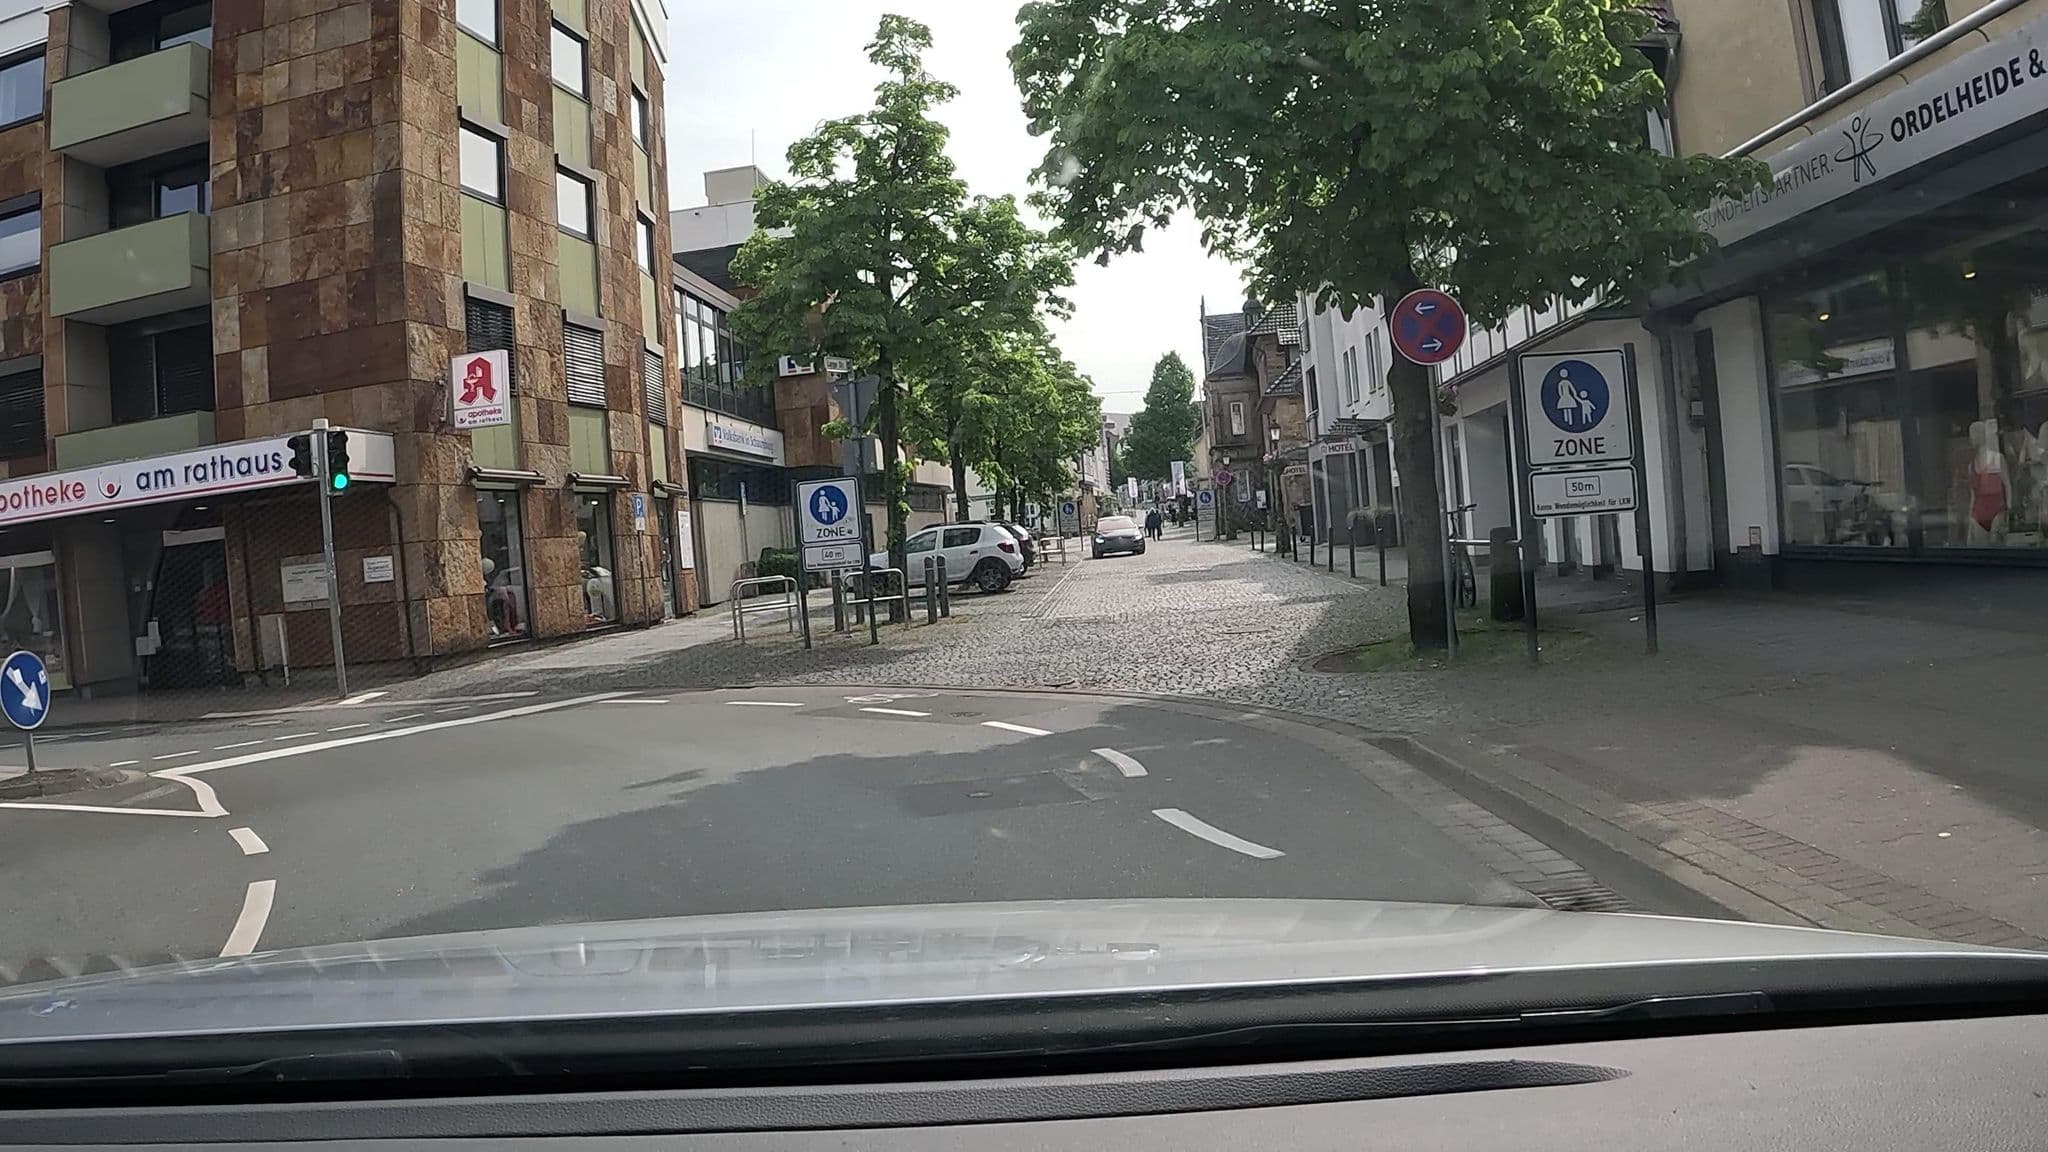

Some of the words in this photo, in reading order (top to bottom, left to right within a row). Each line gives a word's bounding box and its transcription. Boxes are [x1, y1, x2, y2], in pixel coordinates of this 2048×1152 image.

[1891, 56, 2024, 142] ORDELHEIDE
[2028, 48, 2048, 79] &
[467, 408, 502, 418] apotheke
[1328, 443, 1355, 453] HOTEL
[1553, 436, 1607, 457] ZONE
[136, 467, 175, 491] am
[183, 450, 284, 484] rathaus
[635, 498, 642, 517] P
[816, 526, 847, 539] ZONE
